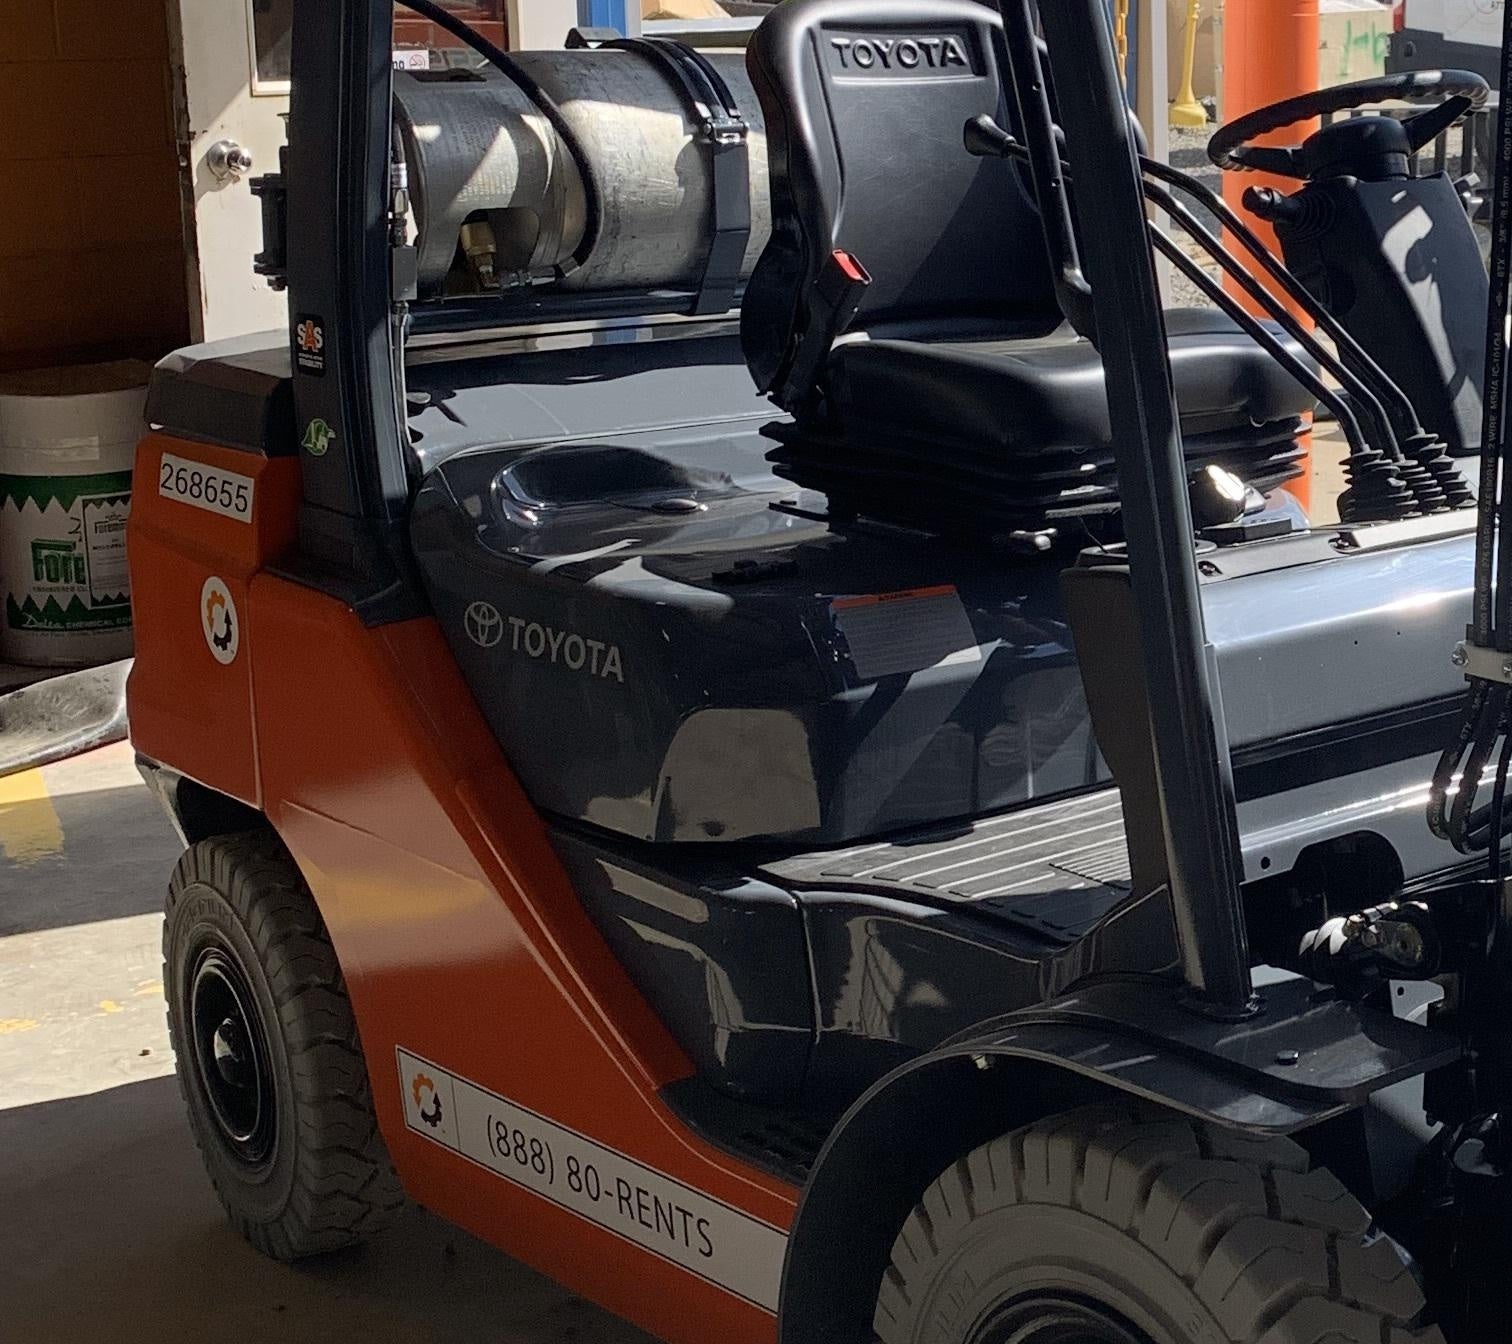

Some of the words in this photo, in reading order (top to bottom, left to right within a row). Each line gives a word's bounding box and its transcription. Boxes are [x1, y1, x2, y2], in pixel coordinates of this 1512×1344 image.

[831, 36, 968, 69] TOYOTA
[296, 319, 324, 353] SAS
[161, 462, 249, 513] 268655
[508, 616, 624, 683] TOYOTA
[487, 1114, 554, 1185] (888)
[567, 1155, 713, 1257] 80-RENTS
